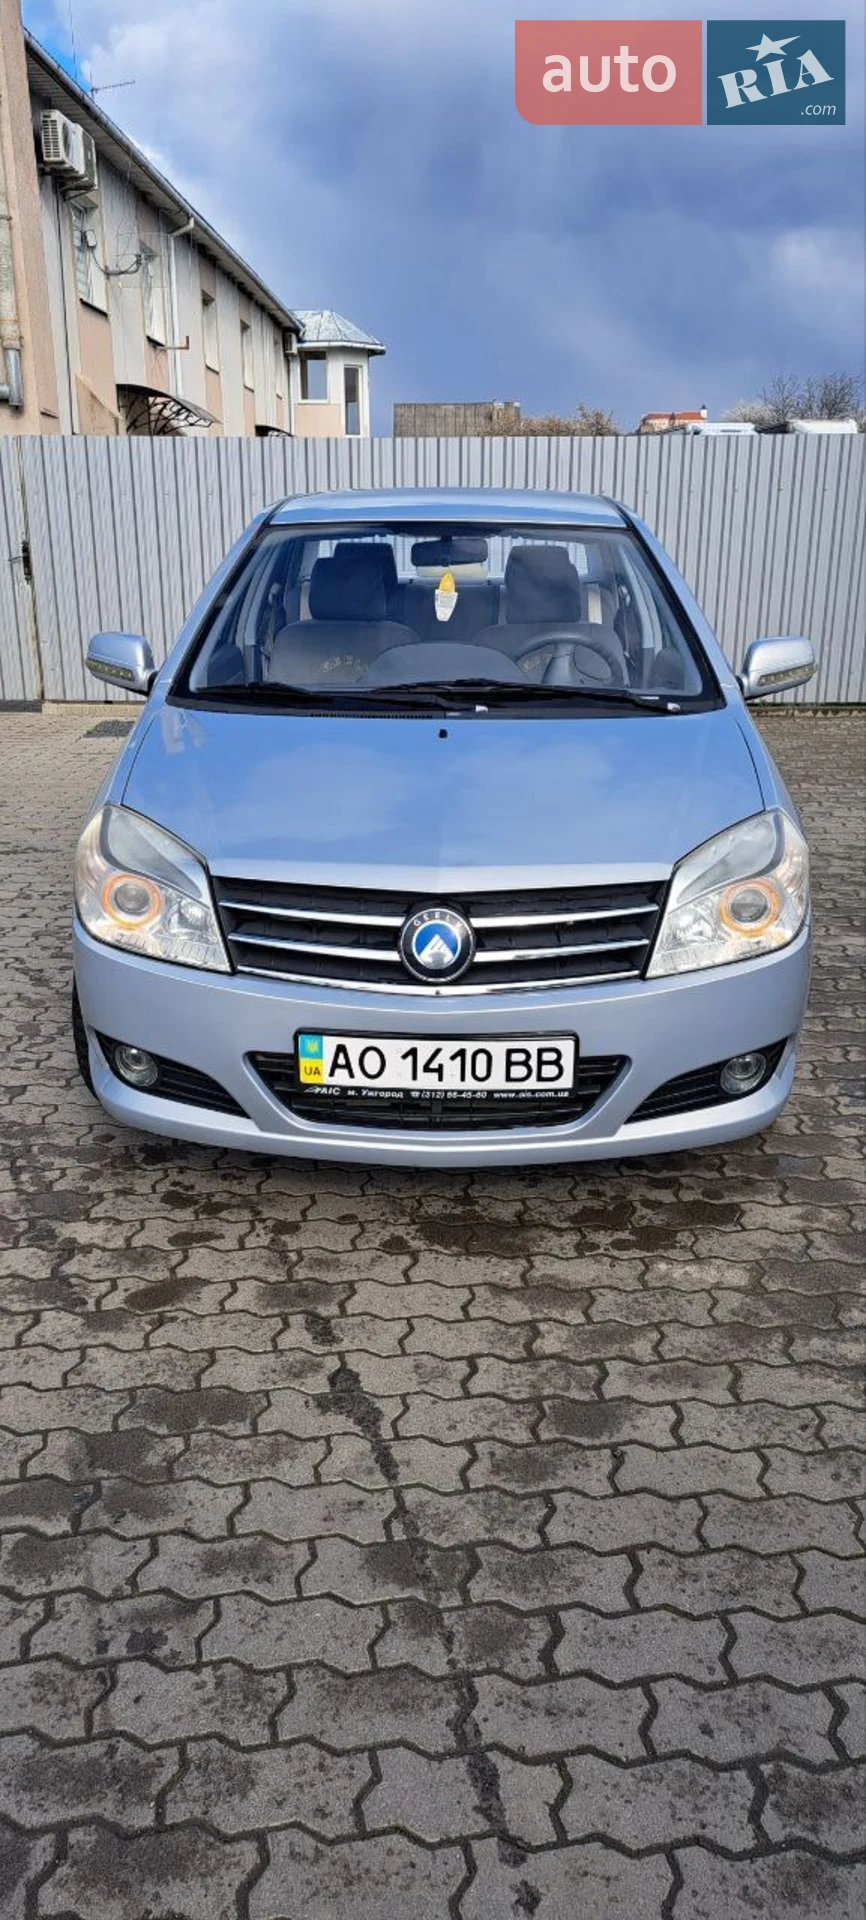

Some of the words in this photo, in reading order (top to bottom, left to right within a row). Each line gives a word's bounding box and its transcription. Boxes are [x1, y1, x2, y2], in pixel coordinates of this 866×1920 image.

[329, 1044, 386, 1080] AO
[400, 1047, 493, 1082] 1410
[505, 1047, 564, 1082] BB
[304, 1066, 321, 1077] UA
[361, 1089, 404, 1099] Ужгород
